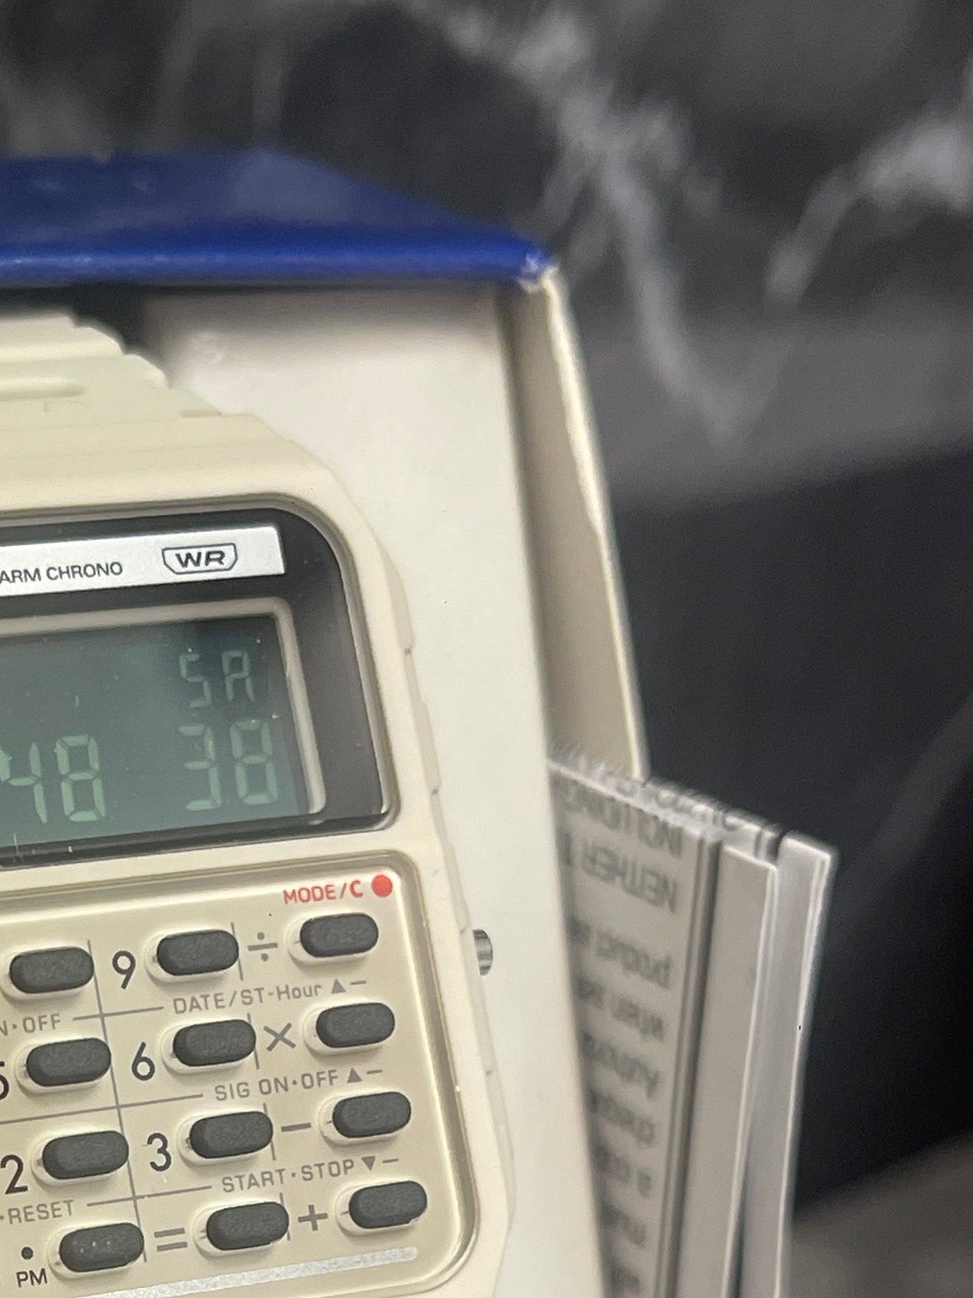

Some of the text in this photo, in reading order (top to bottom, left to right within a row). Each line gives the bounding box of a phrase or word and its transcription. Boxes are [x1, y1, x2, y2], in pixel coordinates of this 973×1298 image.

[45, 561, 125, 582] CHRONO
[174, 548, 229, 570] WR
[178, 718, 280, 813] 38
[282, 879, 364, 906] MODE/C
[111, 950, 137, 990] 9
[131, 1041, 156, 1082] 6
[214, 1080, 252, 1102] SIG
[145, 1132, 173, 1173] 3
[0, 1154, 29, 1196] 2
[16, 1268, 49, 1289] PM
